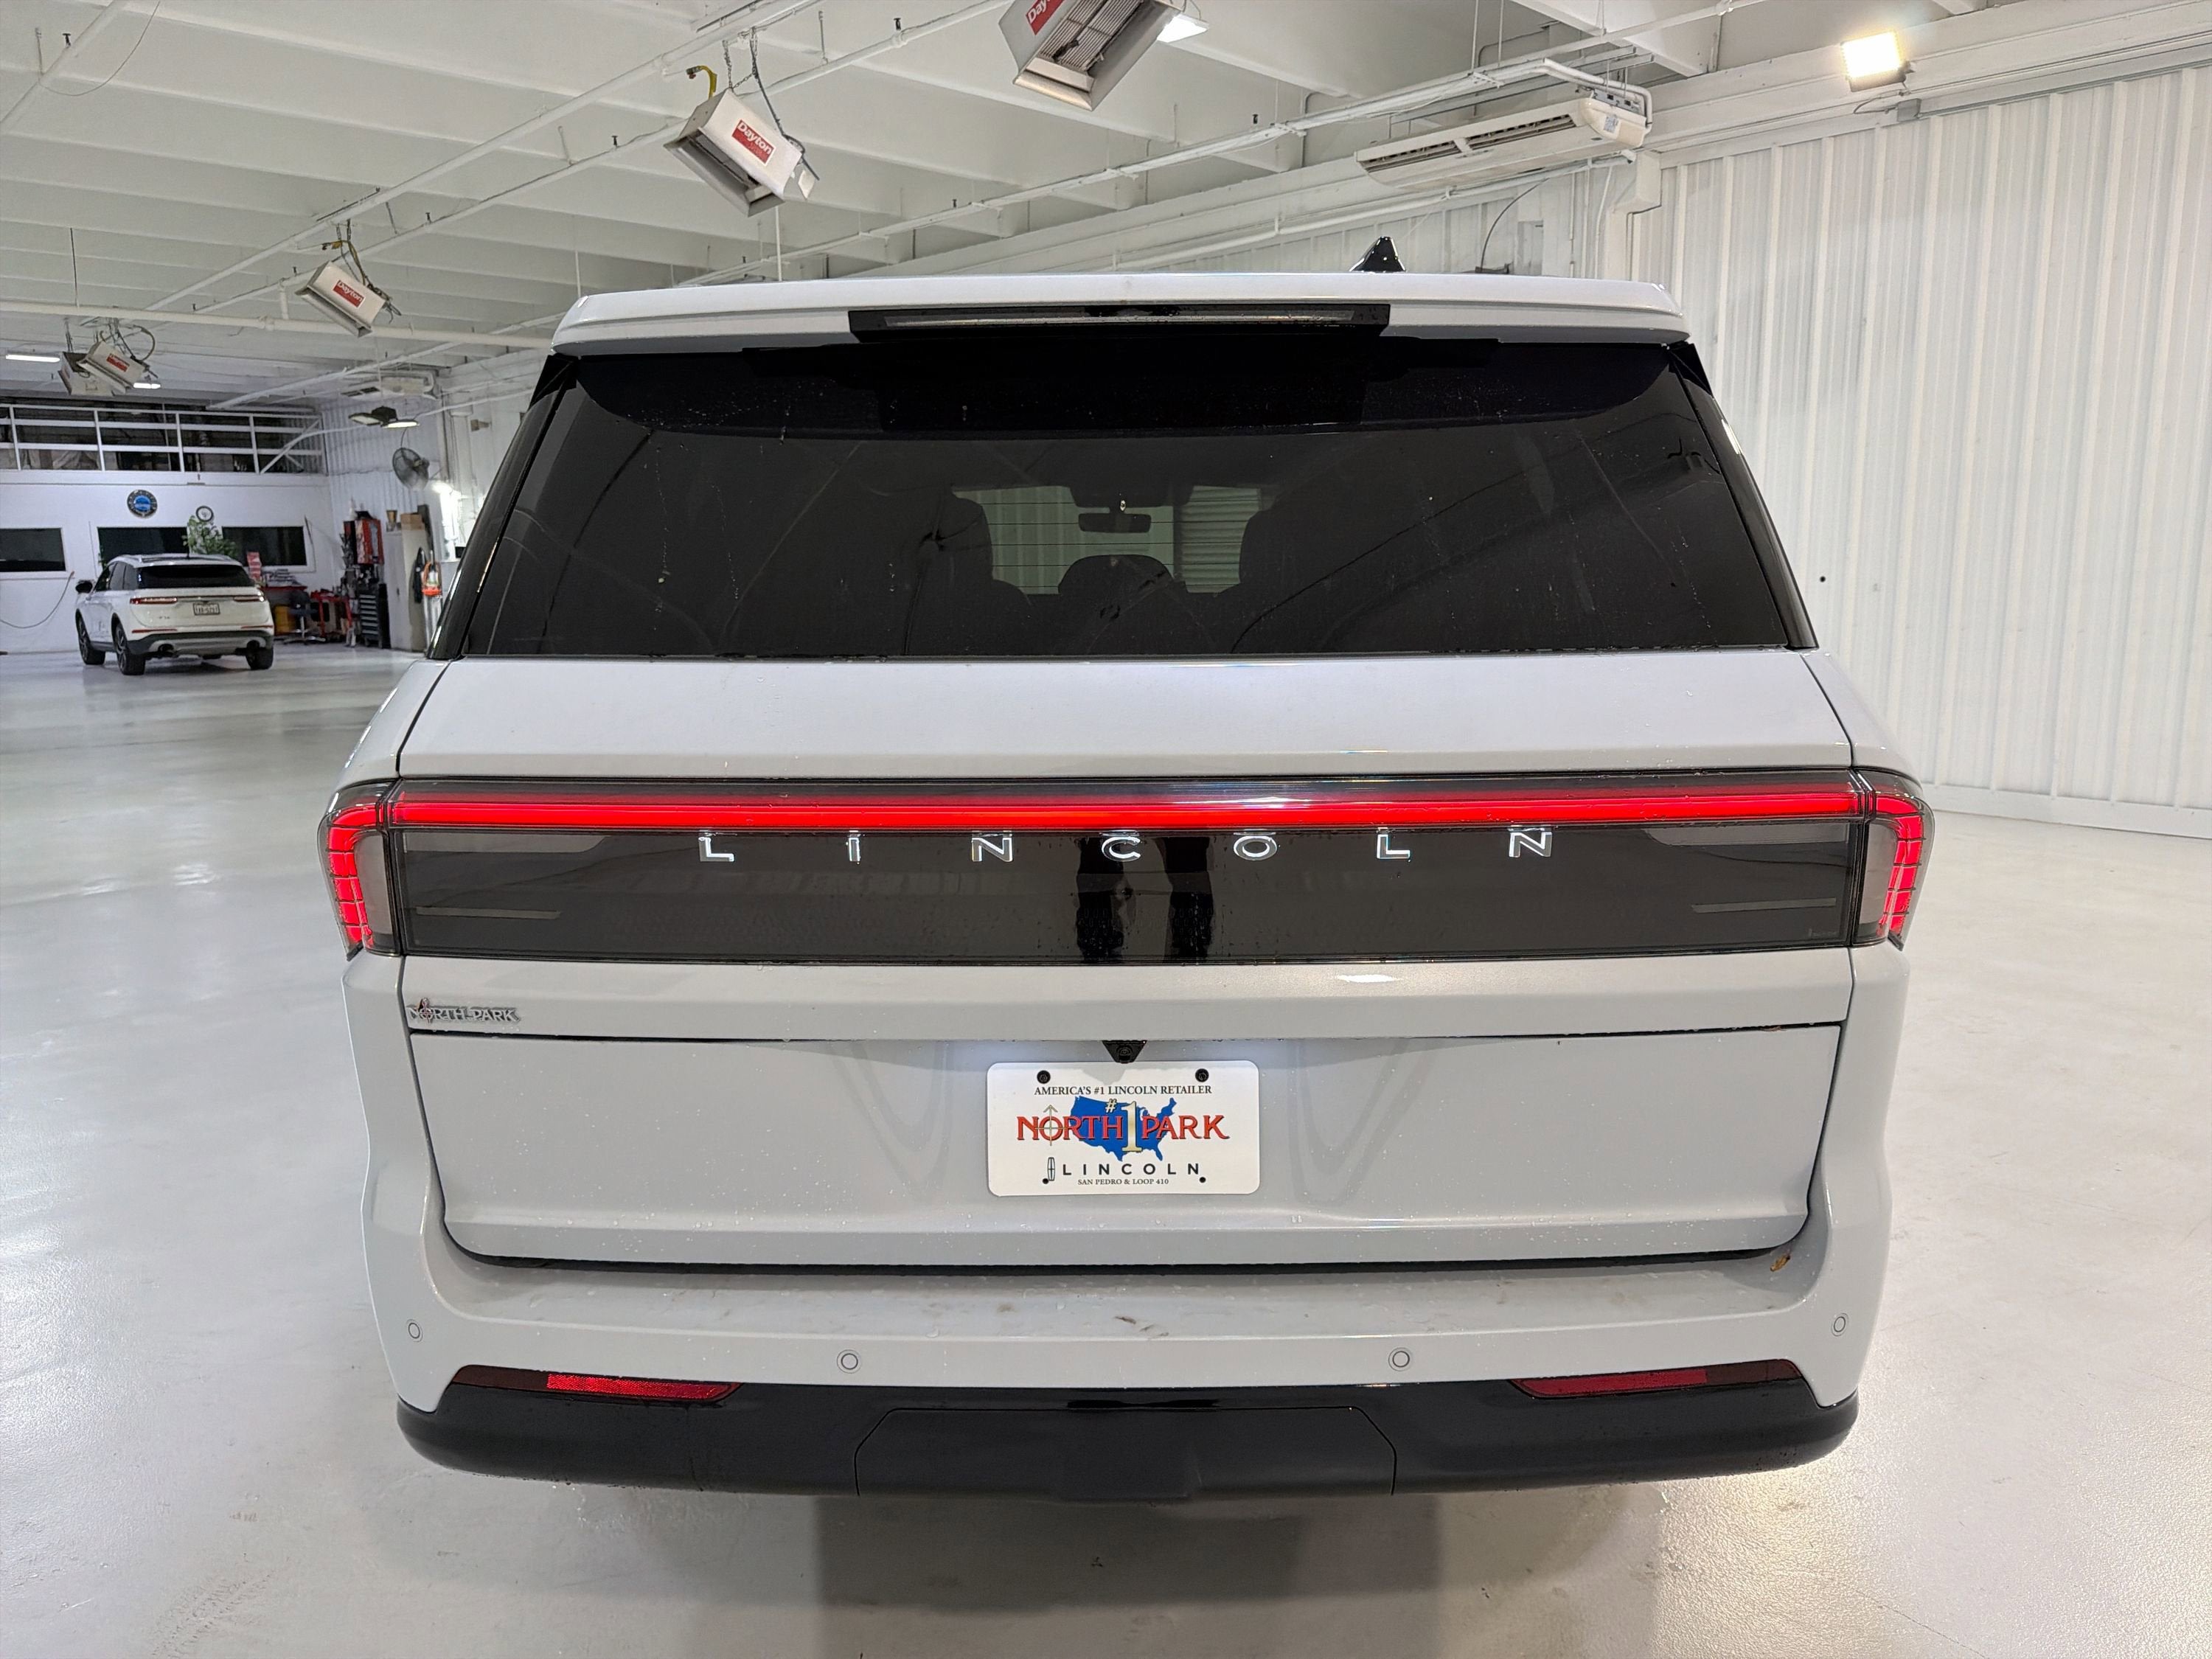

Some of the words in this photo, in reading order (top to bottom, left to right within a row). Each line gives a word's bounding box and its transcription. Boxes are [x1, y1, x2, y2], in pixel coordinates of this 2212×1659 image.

[1028, 0, 1051, 24] Day
[737, 122, 772, 155] Dayton
[698, 830, 1552, 863] LINCOLN
[406, 1006, 467, 1023] NORTH
[471, 1009, 521, 1022] PARK
[1034, 1085, 1091, 1096] AMERICA'S
[1093, 1086, 1105, 1096] #1
[1107, 1085, 1158, 1095] LINCOLN
[1161, 1085, 1212, 1095] RETAILER
[1016, 1115, 1124, 1141] NORTH
[1141, 1114, 1231, 1140] PARK
[1062, 1163, 1199, 1176] LINCOLN
